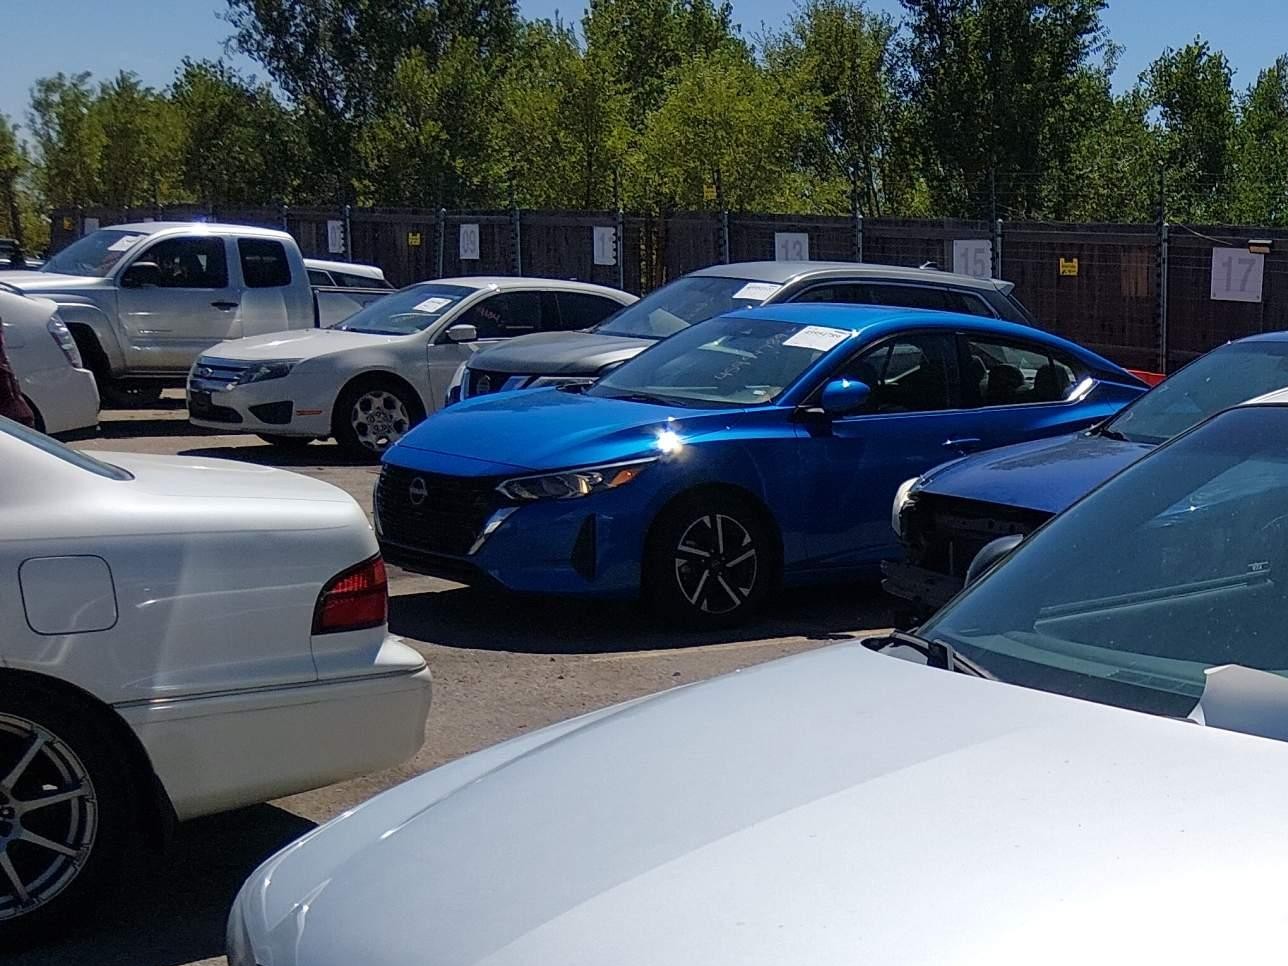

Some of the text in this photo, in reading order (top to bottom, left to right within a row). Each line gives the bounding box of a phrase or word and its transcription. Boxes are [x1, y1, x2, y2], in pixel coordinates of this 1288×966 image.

[781, 240, 803, 261] 13
[960, 247, 985, 276] 15
[1222, 256, 1257, 292] 17
